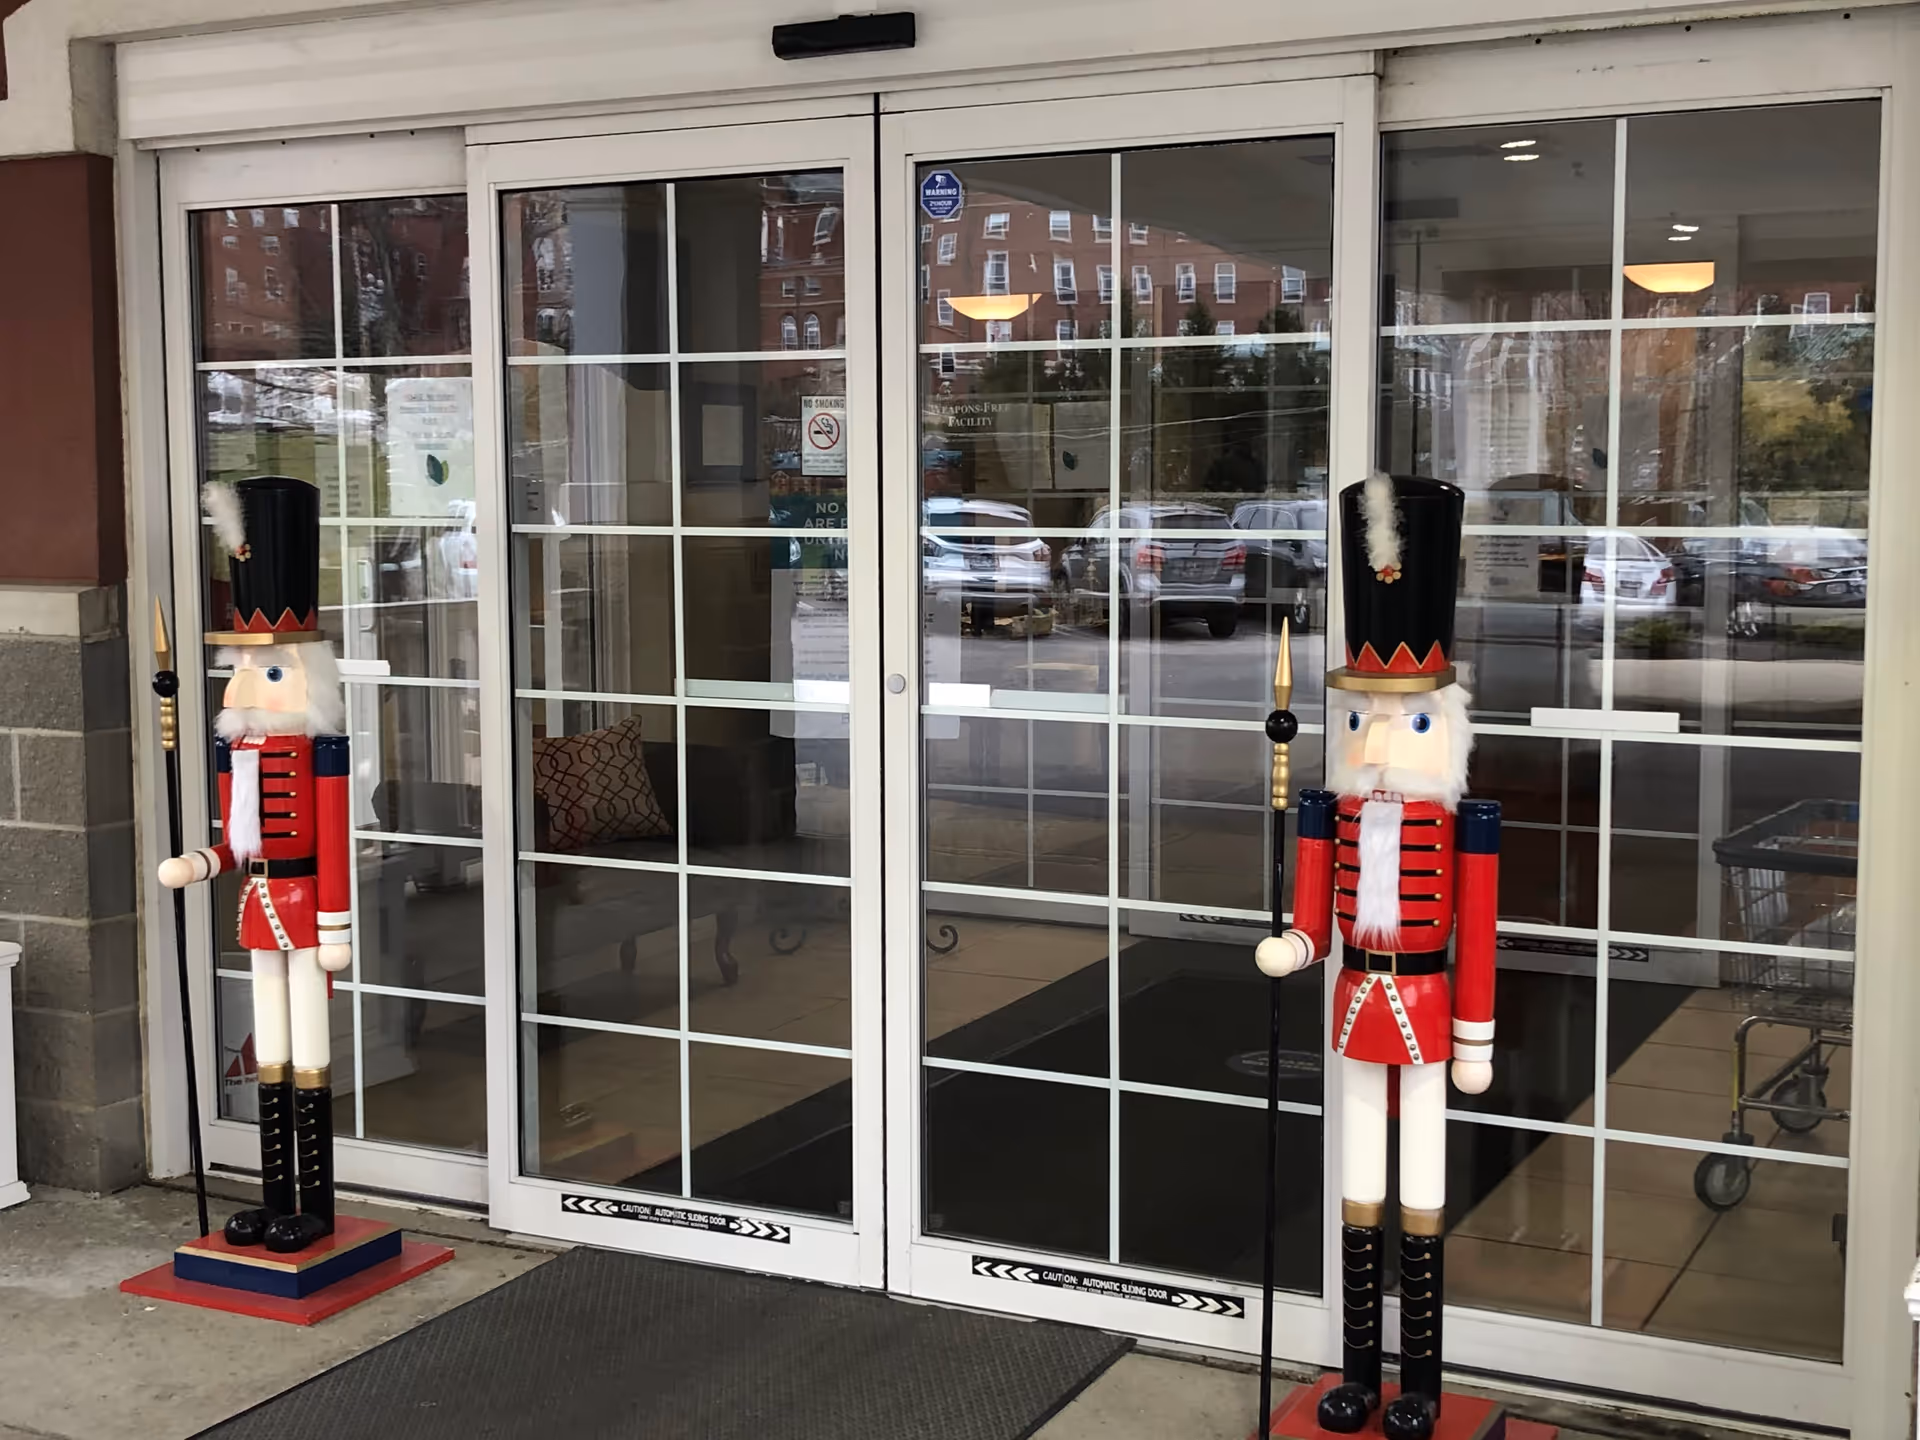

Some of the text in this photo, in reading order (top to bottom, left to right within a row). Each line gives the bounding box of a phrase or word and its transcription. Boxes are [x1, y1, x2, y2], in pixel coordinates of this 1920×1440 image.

[925, 188, 957, 196] WARNING
[803, 399, 844, 408] NO SMOKING
[948, 416, 992, 427] FACILITY
[815, 502, 839, 513] NO
[804, 518, 835, 529] ARE
[655, 1208, 686, 1220] AUTOMATIC
[687, 1212, 708, 1223] SLIDING
[709, 1215, 726, 1226] DOOR
[1042, 1271, 1168, 1300] CAUTION: AUTOMATIC SLIDING DOOR
